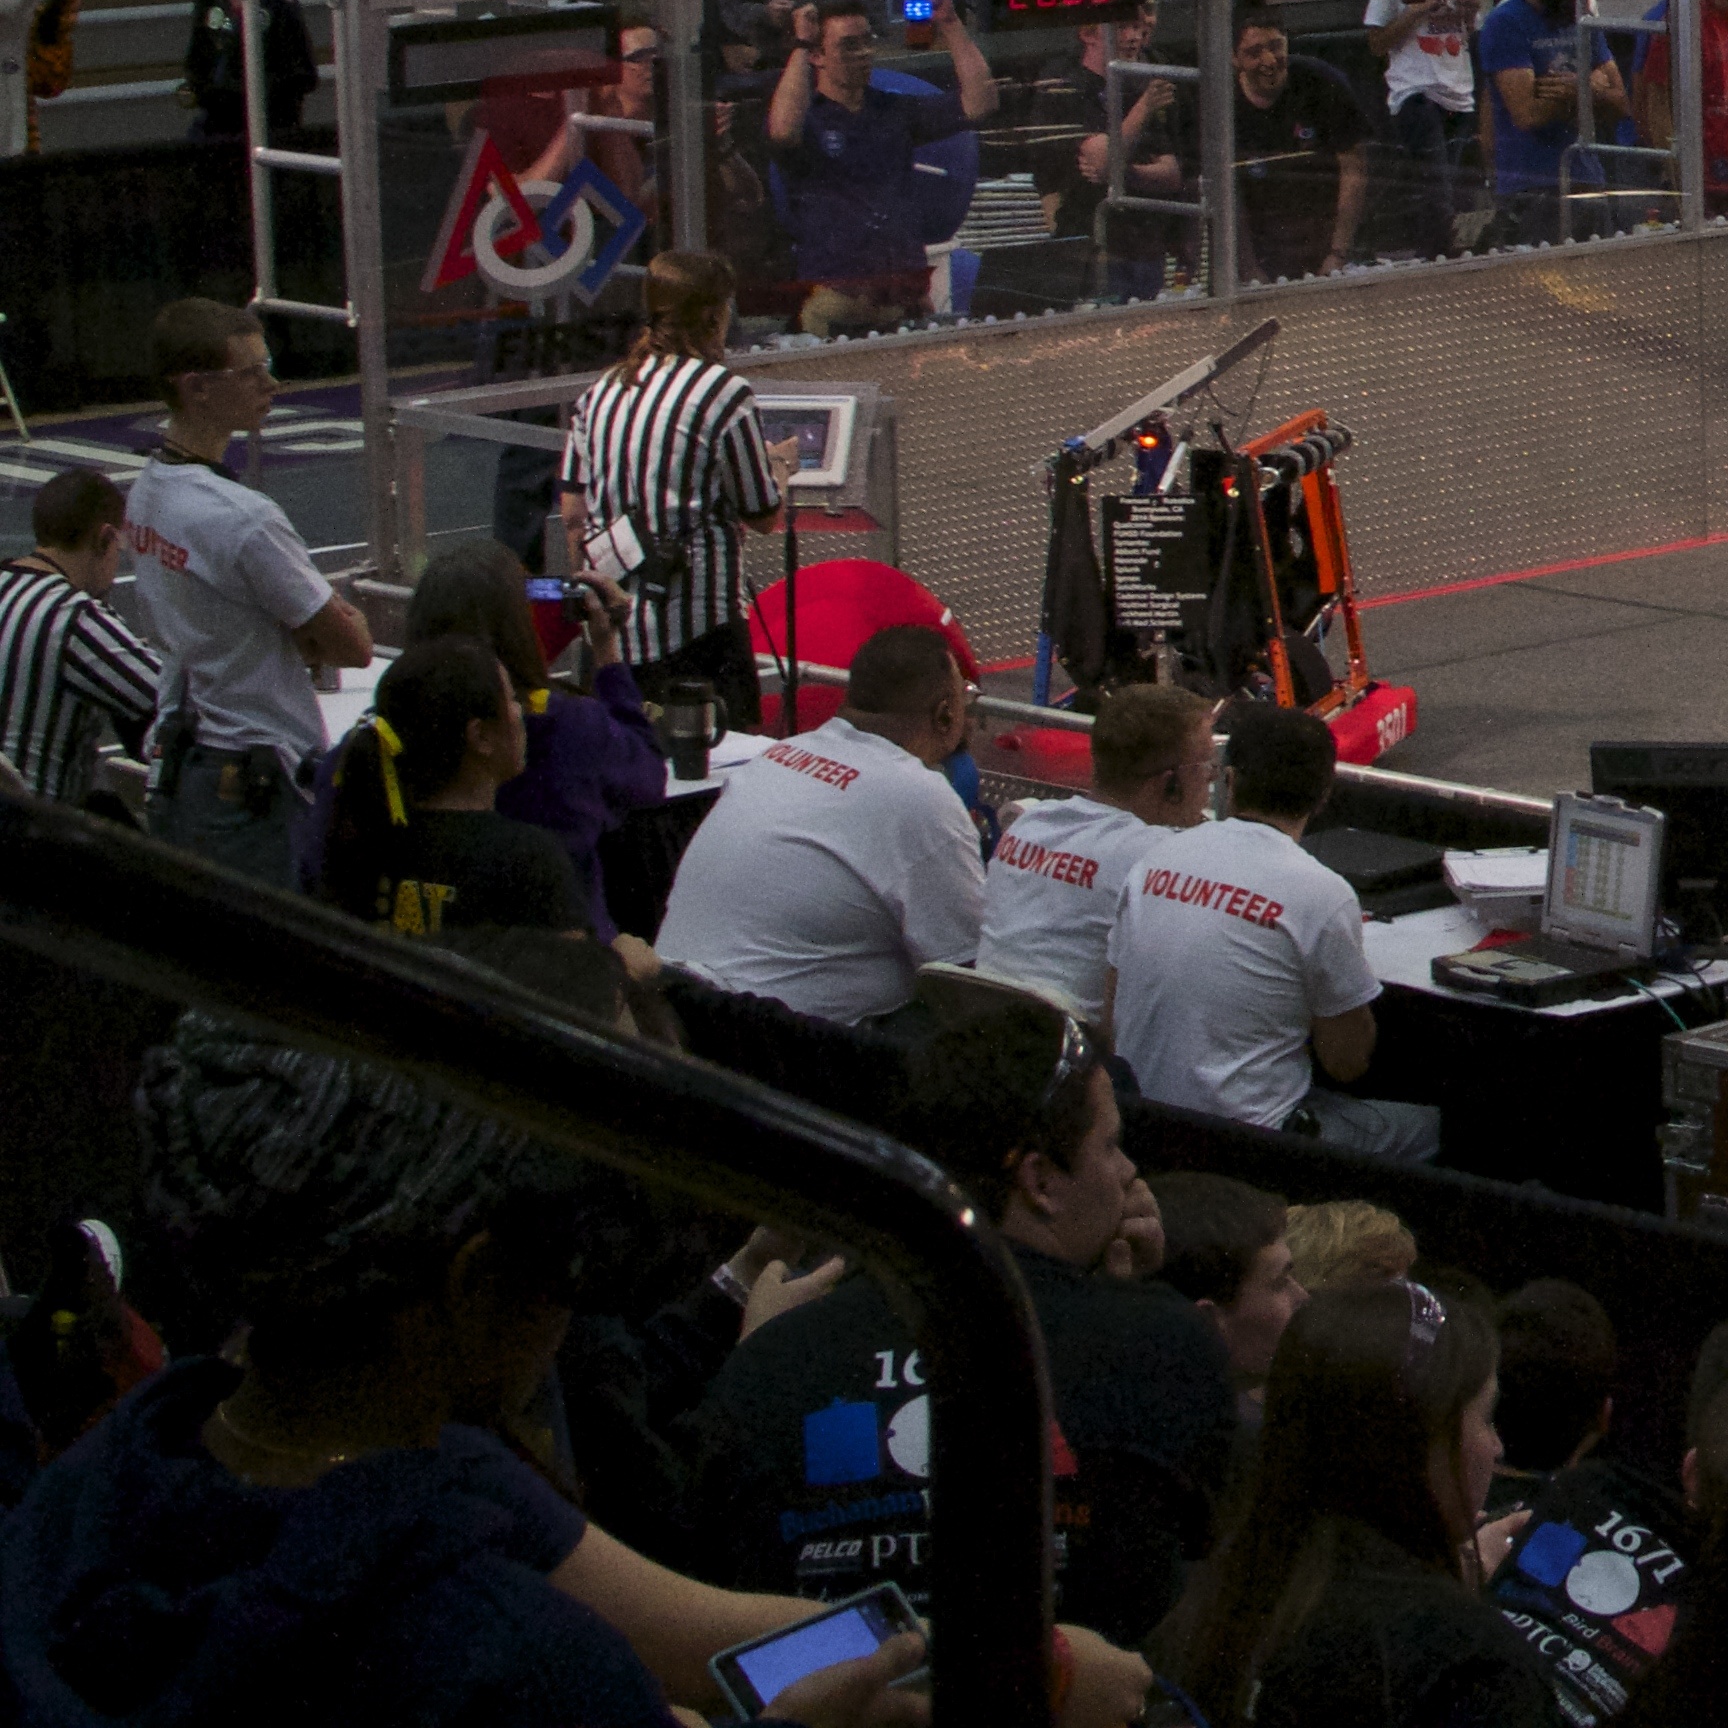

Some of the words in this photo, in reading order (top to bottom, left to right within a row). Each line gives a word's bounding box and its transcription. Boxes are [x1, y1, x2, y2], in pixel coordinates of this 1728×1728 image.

[764, 743, 861, 791] VOLUNTEER
[998, 834, 1100, 890] VOLUNTEER
[1143, 868, 1285, 929] VOLUNTEER
[800, 1539, 863, 1561] PELCO
